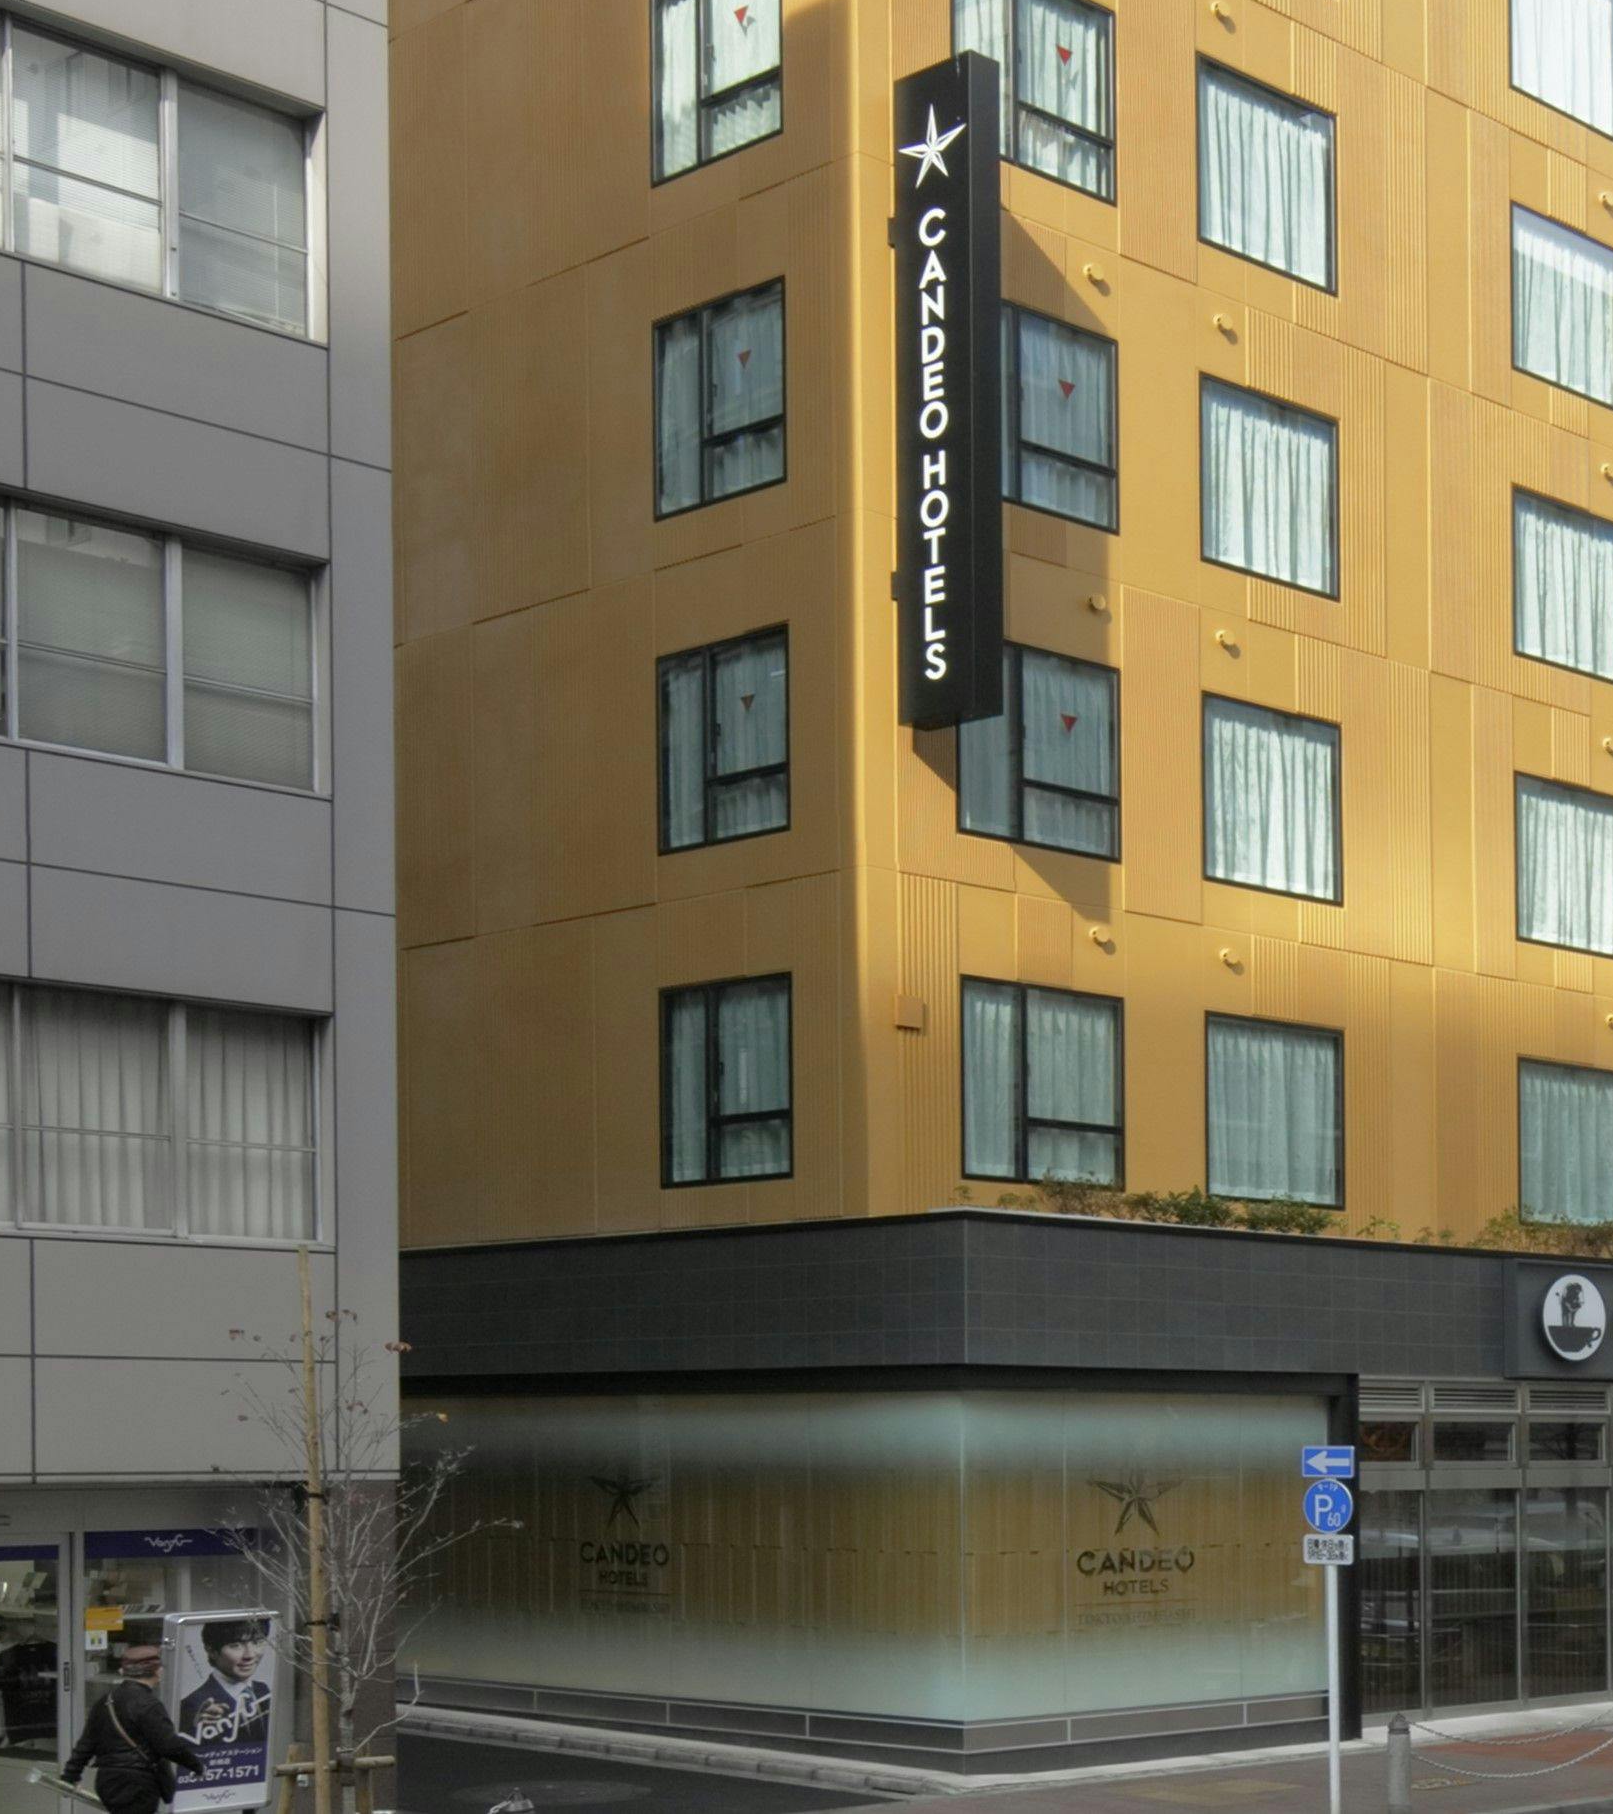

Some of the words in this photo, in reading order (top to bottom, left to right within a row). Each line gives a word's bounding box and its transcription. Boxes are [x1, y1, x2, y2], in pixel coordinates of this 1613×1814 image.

[918, 206, 950, 440] CANDEO
[920, 447, 950, 681] HOTELS
[1314, 1493, 1334, 1527] P
[580, 1541, 670, 1566] CANDEO
[1076, 1547, 1195, 1576] CANDEO
[597, 1570, 649, 1587] HOTELS
[1102, 1578, 1170, 1597] HOTELS
